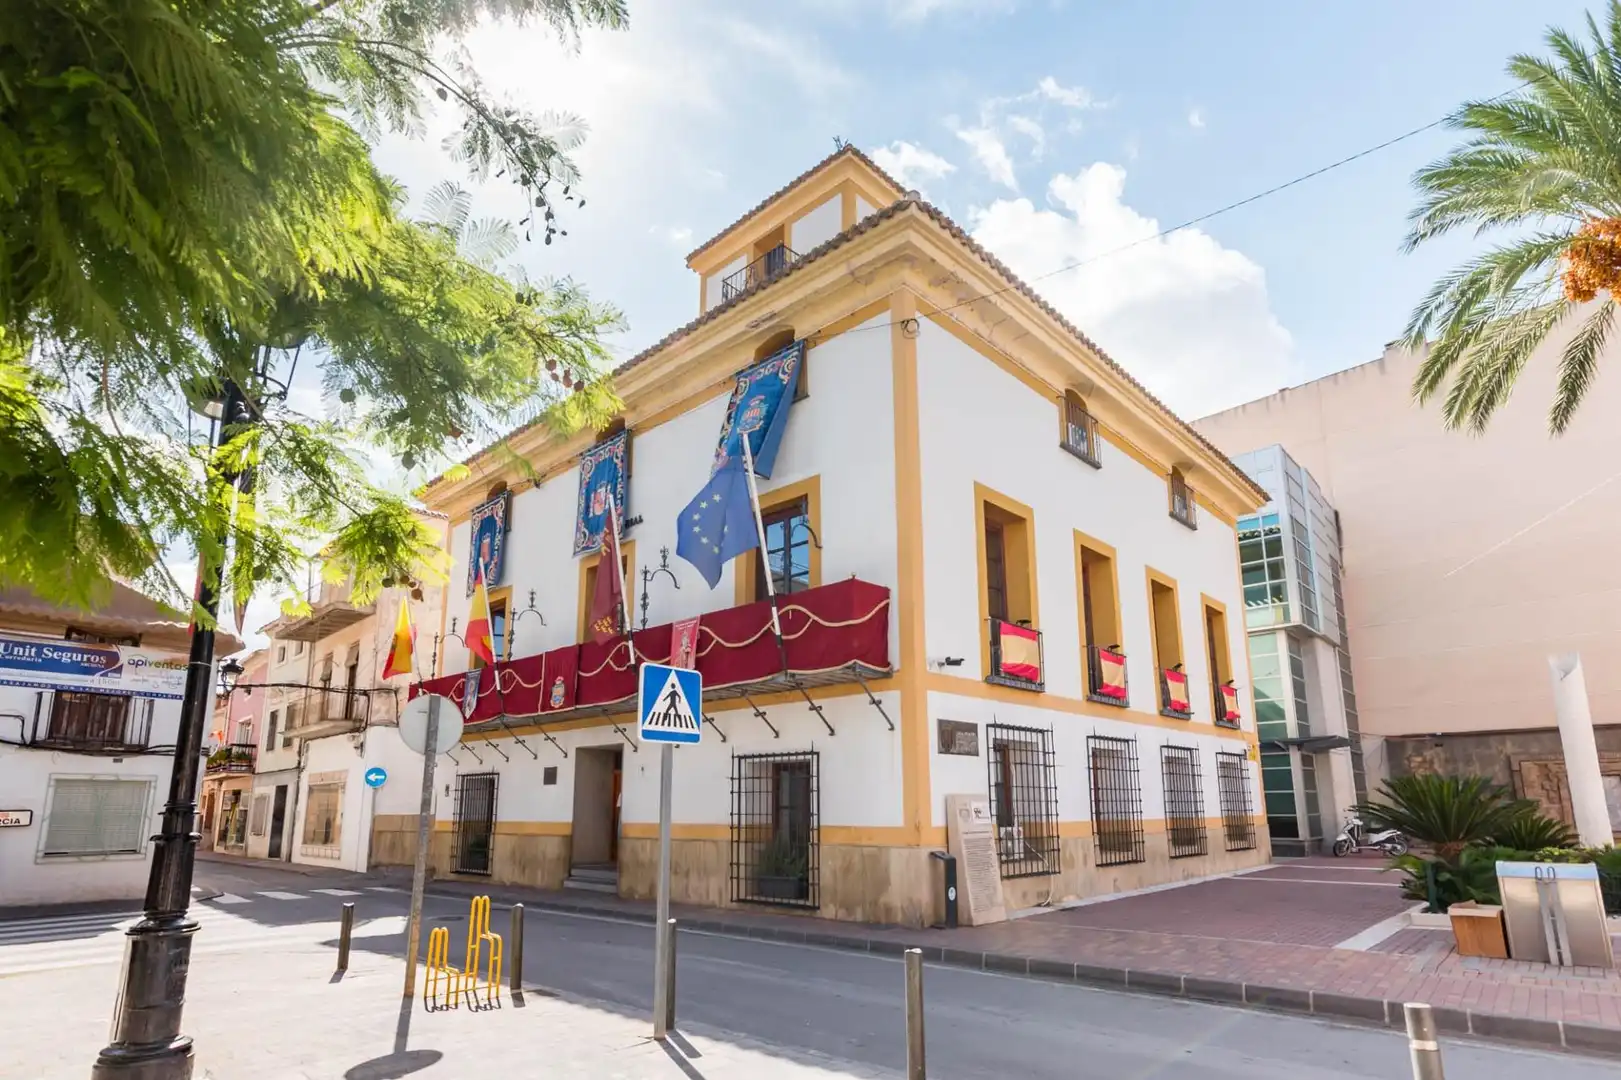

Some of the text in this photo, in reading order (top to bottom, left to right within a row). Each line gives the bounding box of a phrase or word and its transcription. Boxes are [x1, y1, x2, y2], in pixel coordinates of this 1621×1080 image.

[0, 642, 107, 664] Unit Seguros
[128, 658, 189, 671] apiventas
